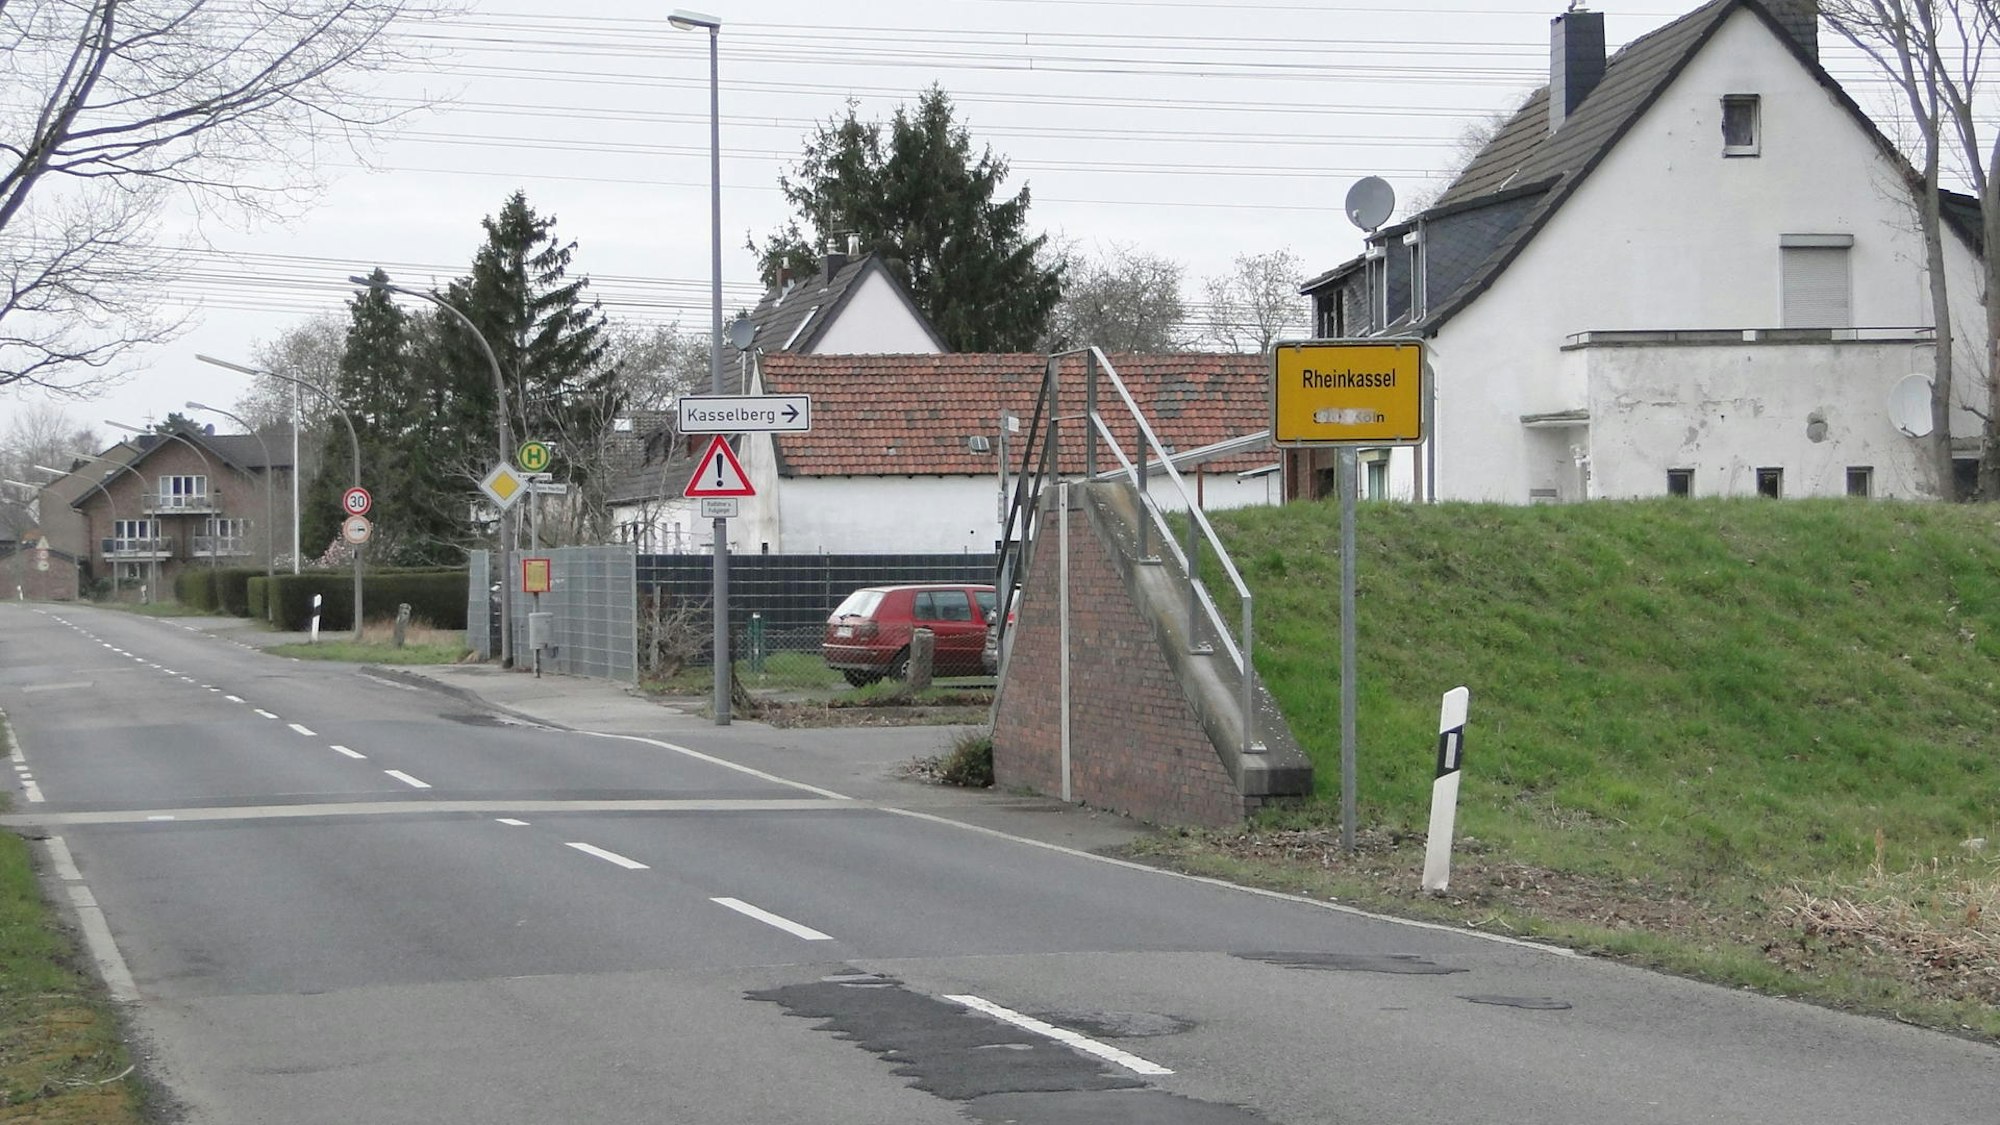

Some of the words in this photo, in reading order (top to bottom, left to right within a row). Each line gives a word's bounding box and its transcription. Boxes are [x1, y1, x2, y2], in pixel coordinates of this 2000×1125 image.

[1302, 368, 1396, 388] Rheinkassel
[688, 408, 775, 424] Kasselberg
[528, 448, 541, 464] H
[350, 495, 365, 508] 30
